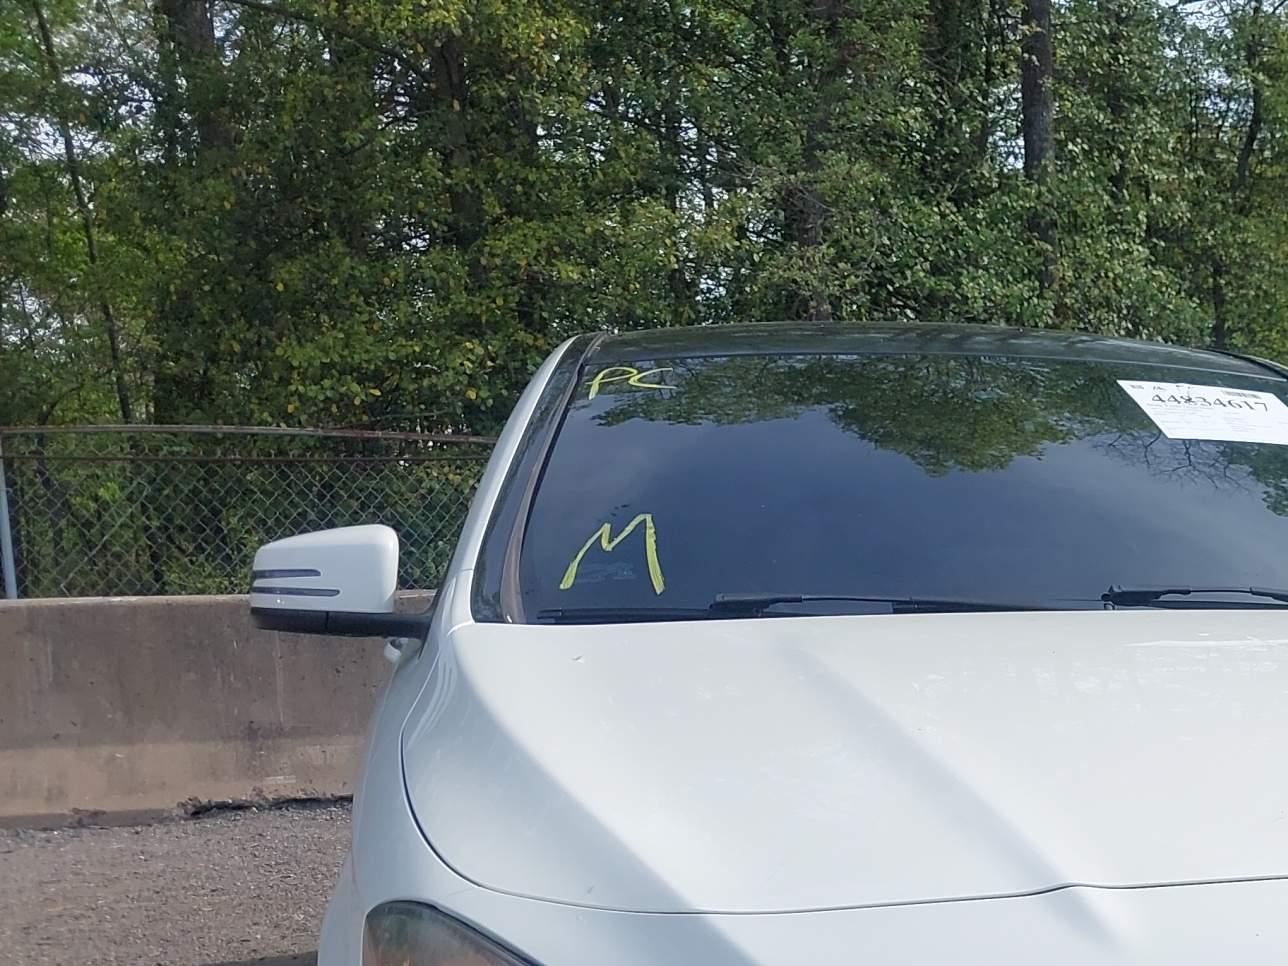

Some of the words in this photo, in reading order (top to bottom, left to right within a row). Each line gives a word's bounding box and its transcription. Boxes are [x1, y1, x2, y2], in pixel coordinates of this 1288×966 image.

[585, 366, 677, 400] PC
[1151, 393, 1269, 412] 44834617
[559, 513, 666, 596] M
